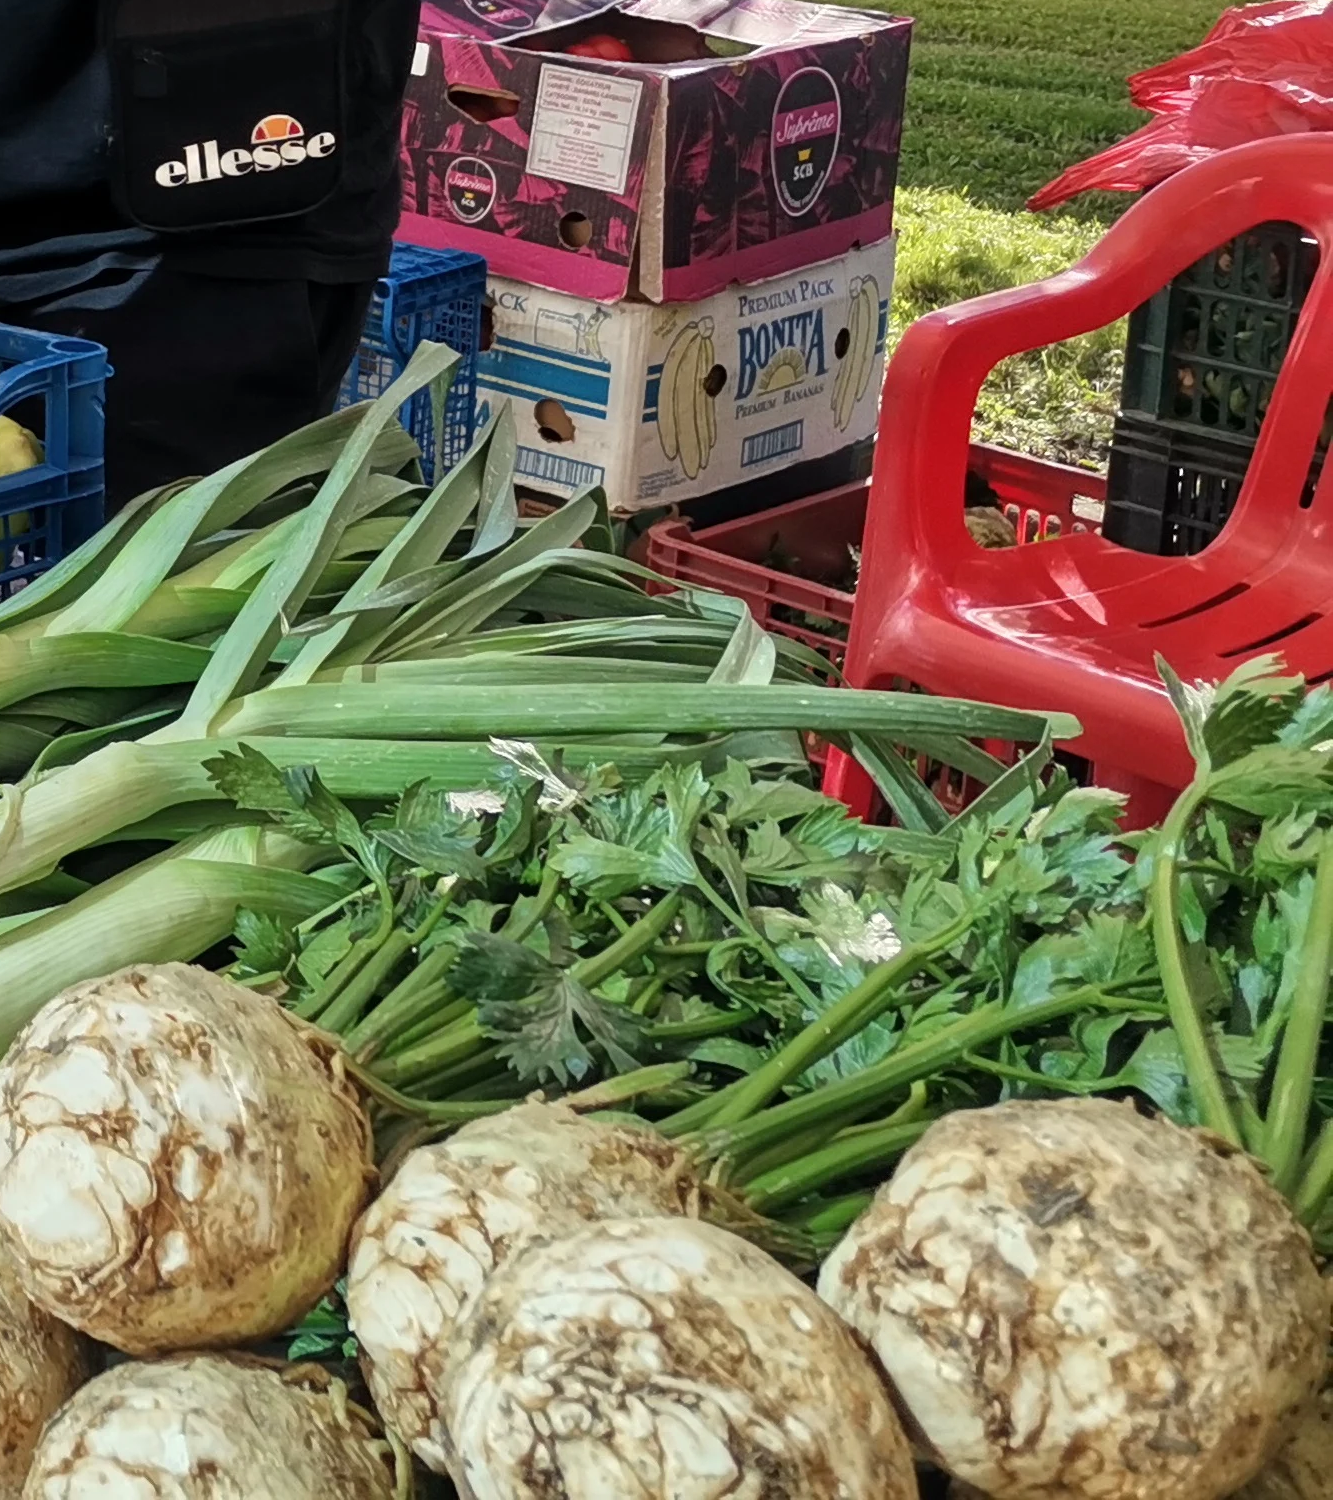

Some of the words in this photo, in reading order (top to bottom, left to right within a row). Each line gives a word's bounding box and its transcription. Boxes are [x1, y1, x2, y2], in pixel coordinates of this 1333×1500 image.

[776, 110, 836, 144] Suprême
[155, 131, 336, 187] ellesse
[793, 162, 814, 181] SCB
[487, 287, 530, 313] ACK
[738, 288, 797, 318] PREMIUM
[798, 278, 835, 302] PACK
[734, 306, 830, 401] BONITA
